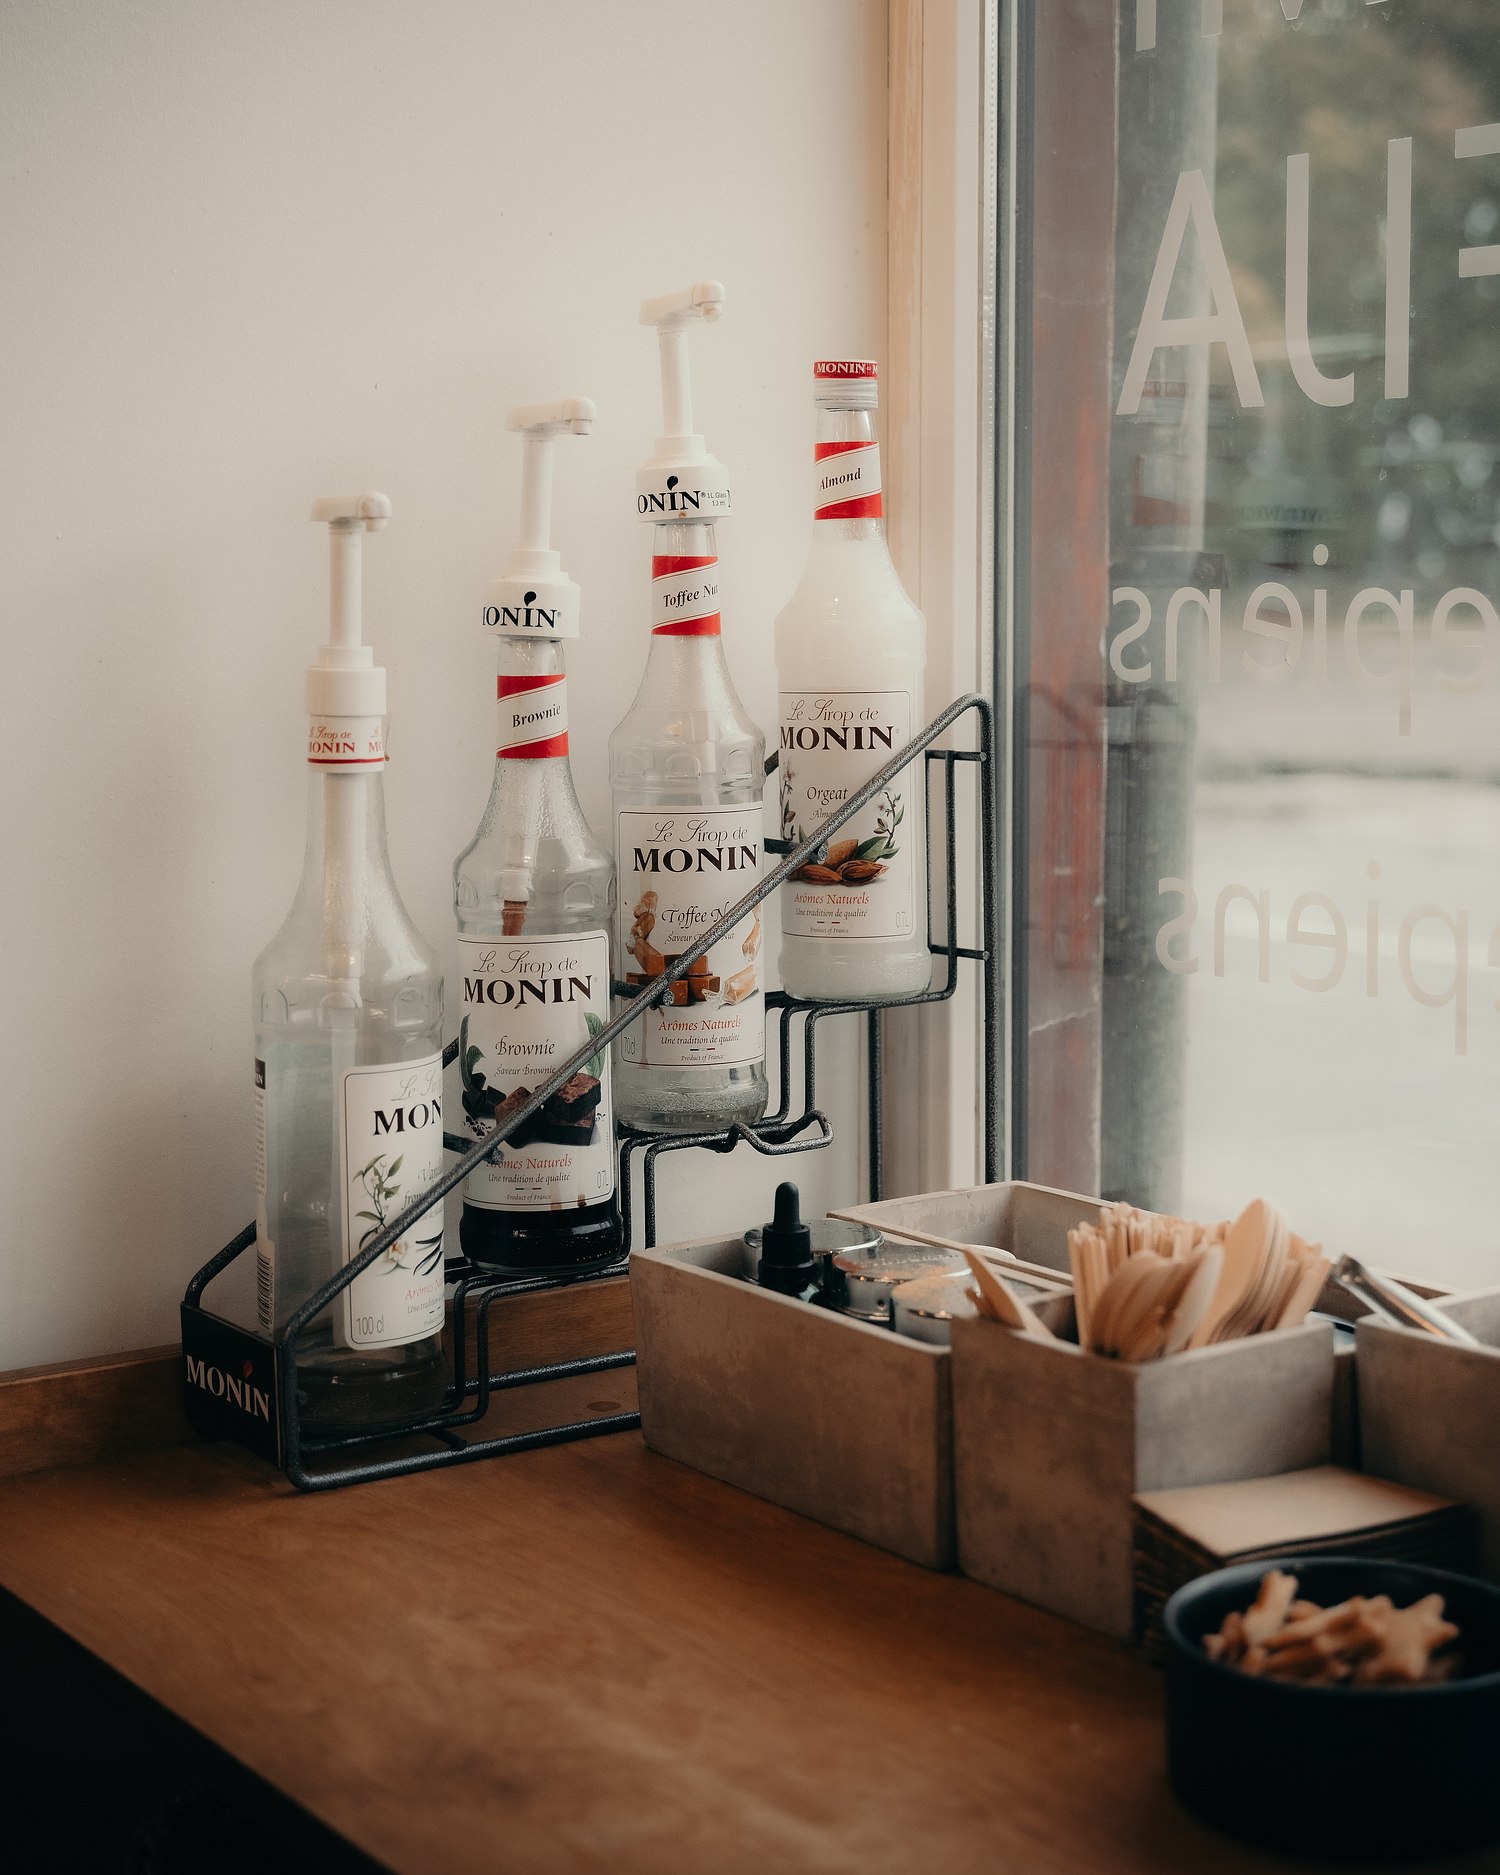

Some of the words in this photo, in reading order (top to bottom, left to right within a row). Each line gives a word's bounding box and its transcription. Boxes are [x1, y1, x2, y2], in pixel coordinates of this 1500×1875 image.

[816, 362, 866, 374] MONIN
[818, 467, 862, 492] Almond
[663, 589, 700, 608] Toffee
[482, 606, 558, 628] ONIN
[512, 703, 561, 728] Brownie
[786, 698, 805, 721] Le
[808, 698, 854, 727] Sirop
[859, 707, 879, 721] de
[341, 731, 352, 739] de
[780, 725, 894, 751] MONIN
[806, 785, 848, 806] Orgeat
[646, 819, 673, 842] Le
[679, 818, 728, 847] Sirop
[732, 826, 748, 840] de
[633, 843, 758, 873] MONIN
[826, 891, 870, 905] Naturels
[661, 905, 707, 929] Toffee
[806, 908, 834, 917] tradition
[834, 908, 841, 917] de
[664, 930, 693, 945] Saveur
[473, 950, 497, 974] Le
[501, 949, 553, 979] Sirop
[558, 956, 578, 971] de
[464, 975, 593, 1005] MONIN
[658, 1019, 698, 1031] Arômes
[701, 1015, 741, 1031] Naturels
[495, 1035, 555, 1056] Brownie
[661, 1036, 676, 1045] Une
[677, 1035, 708, 1045] tradition
[709, 1034, 718, 1044] de
[701, 1054, 707, 1062] of
[494, 1064, 521, 1077] Saveur
[522, 1063, 556, 1075] Brownie
[527, 1153, 572, 1170] Naturels
[488, 1173, 502, 1182] Une
[502, 1173, 534, 1183] tradition
[535, 1173, 544, 1183] de
[526, 1193, 533, 1202] of
[356, 1316, 375, 1336] 100
[376, 1314, 385, 1334] cl
[186, 1354, 270, 1423] MONIN
